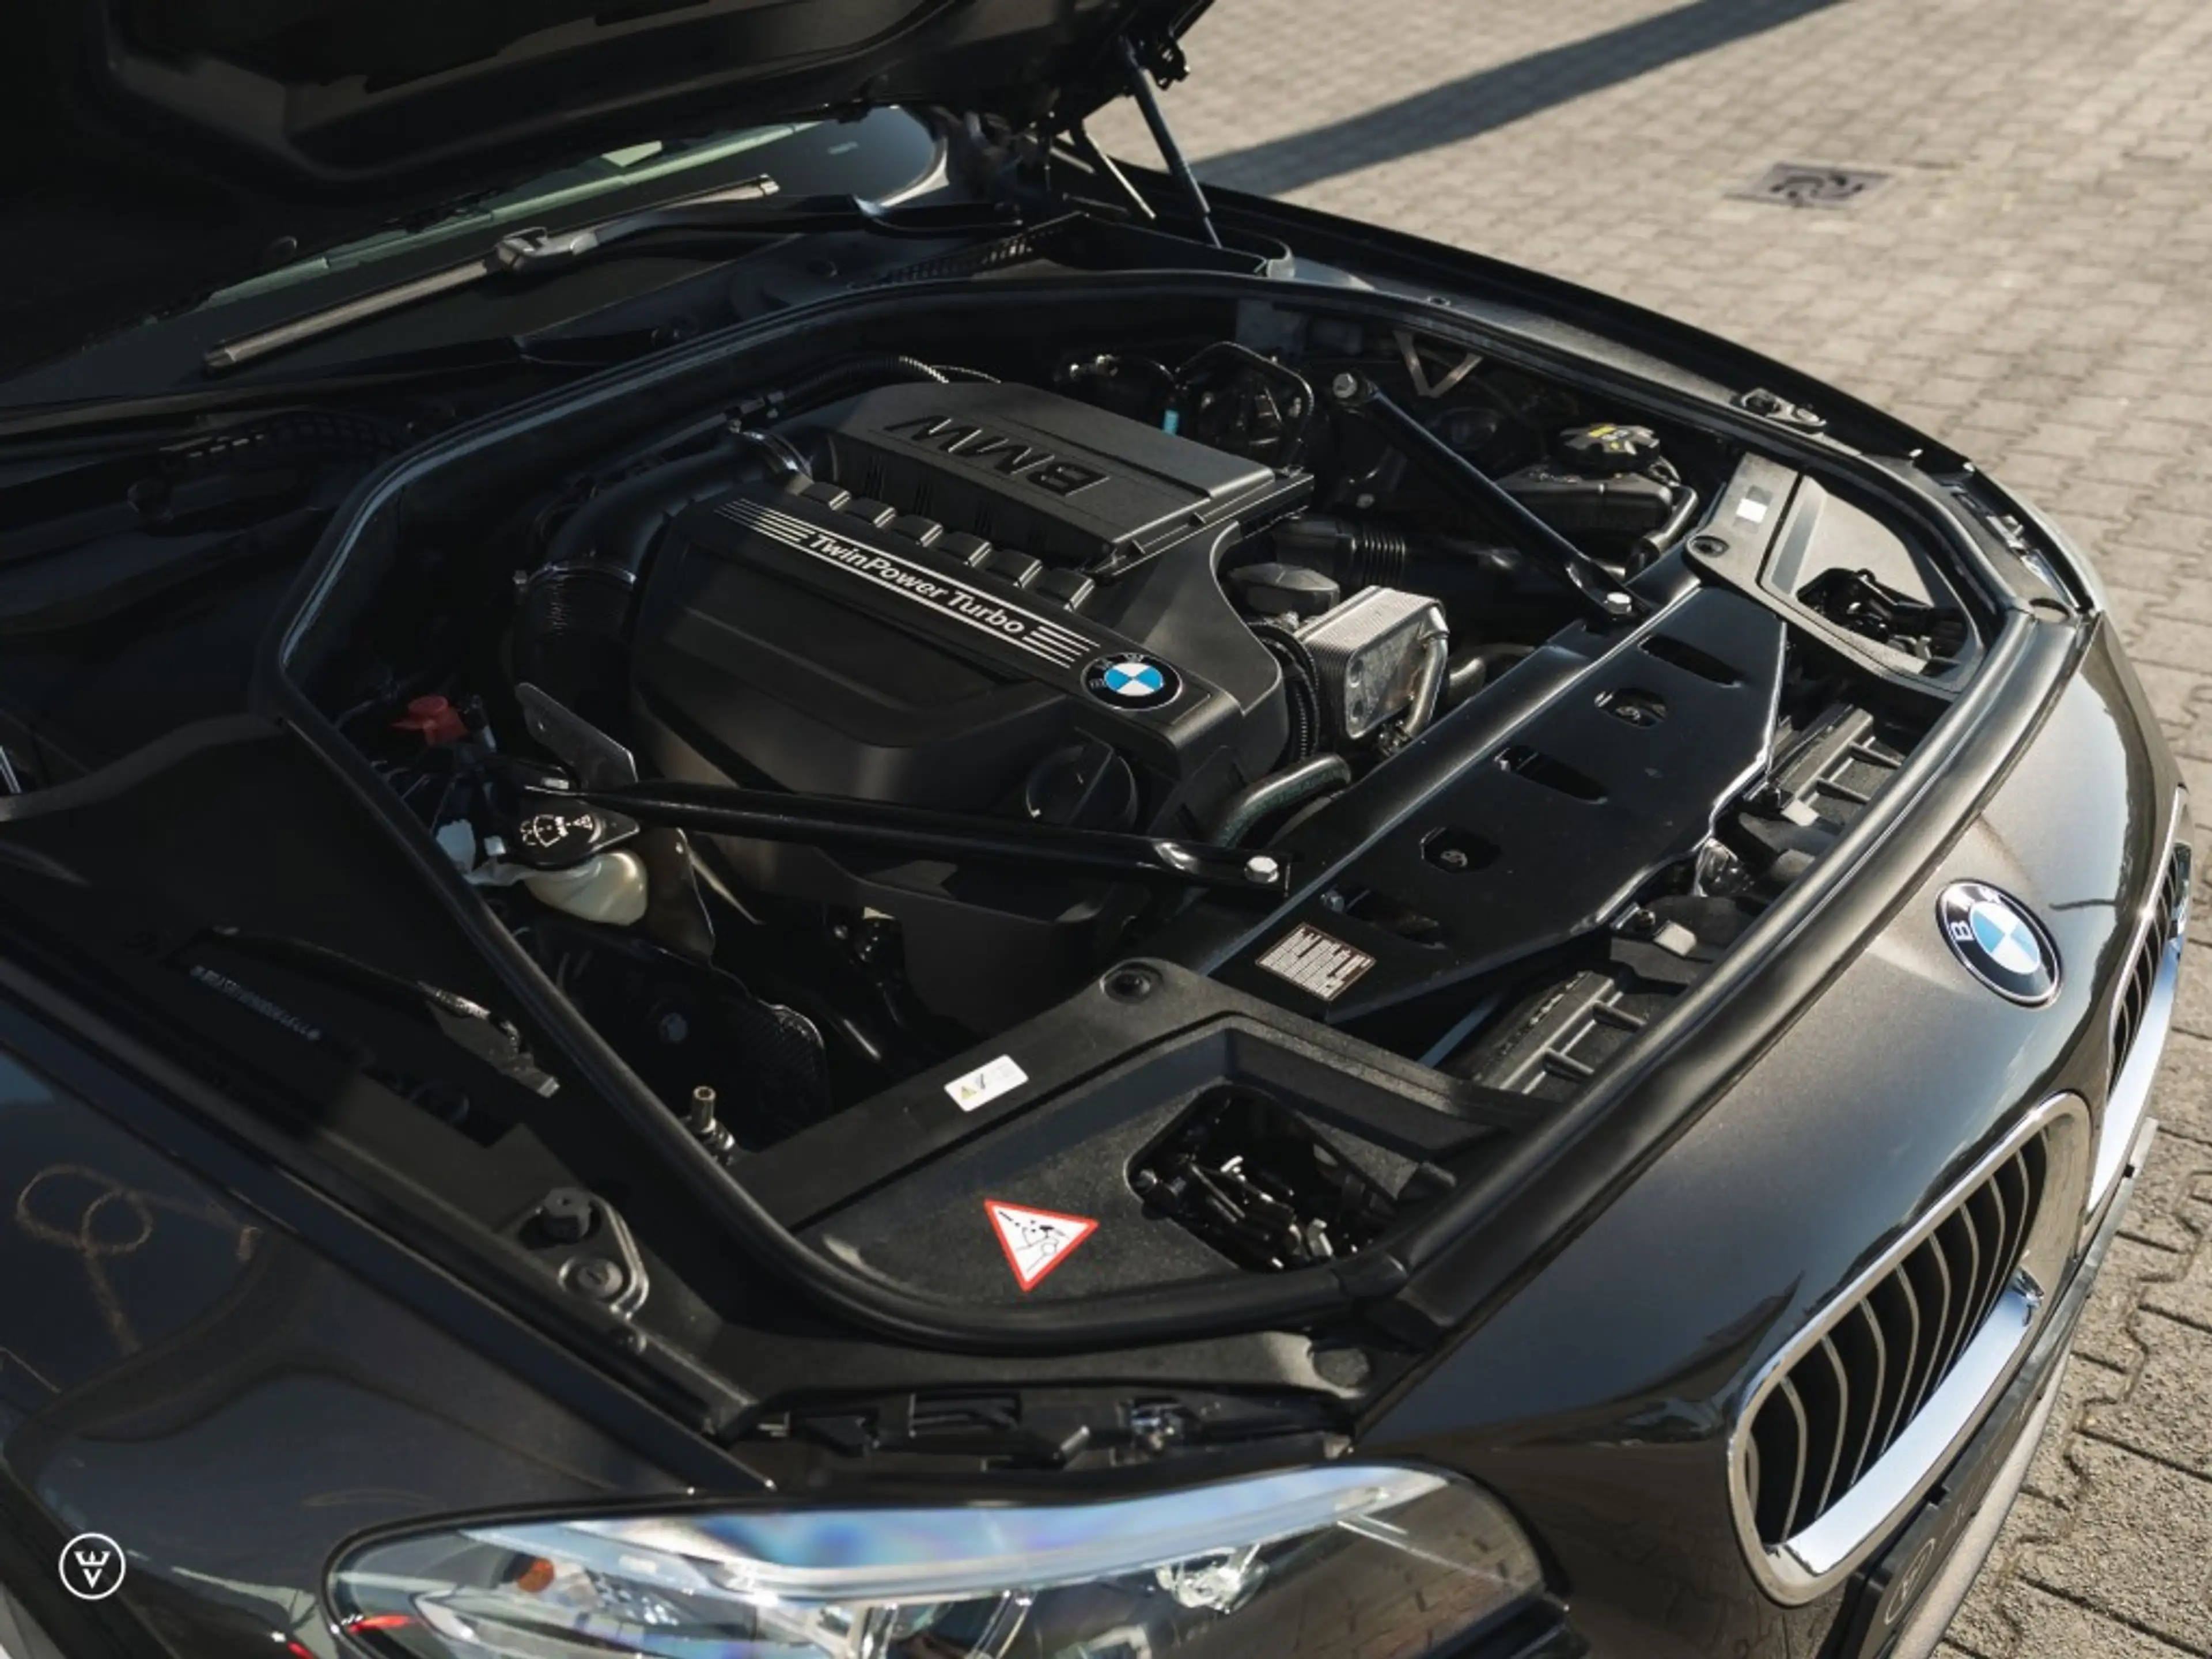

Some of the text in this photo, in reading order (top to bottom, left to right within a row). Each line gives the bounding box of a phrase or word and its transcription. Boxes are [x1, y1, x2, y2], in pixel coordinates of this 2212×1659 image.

[883, 415, 1110, 497] BMW
[809, 534, 1024, 634] TwinPower Turbo
